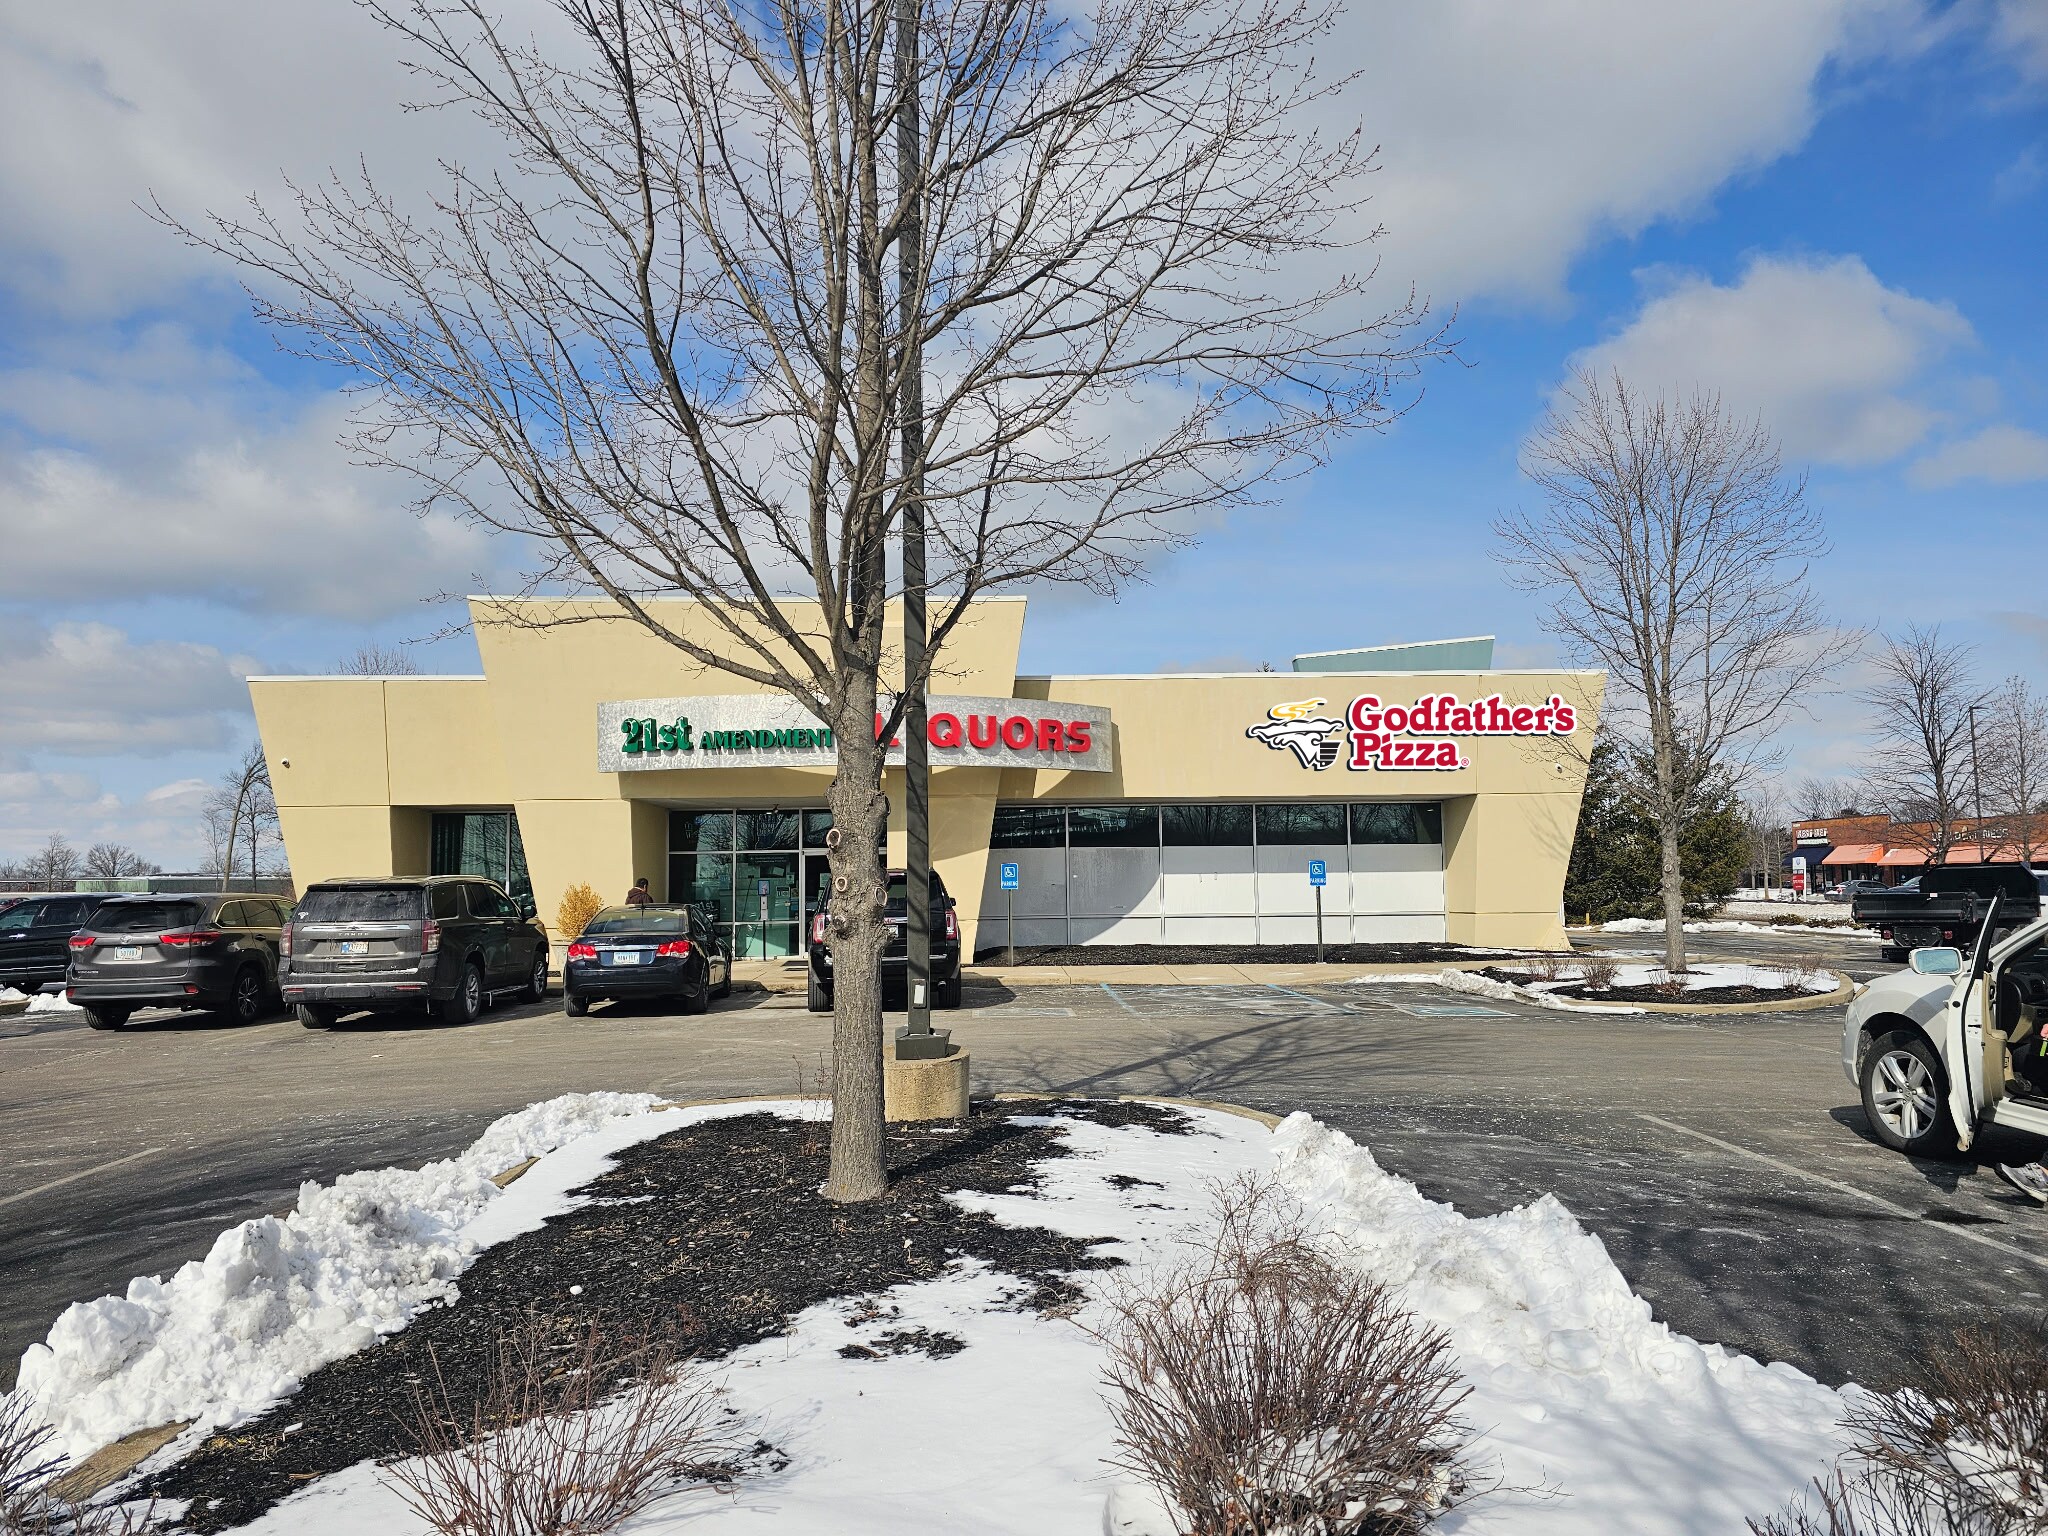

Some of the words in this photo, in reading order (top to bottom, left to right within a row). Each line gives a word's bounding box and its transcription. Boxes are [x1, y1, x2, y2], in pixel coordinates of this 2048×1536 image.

[1351, 696, 1576, 732] Godfather's
[621, 715, 695, 753] 21st
[699, 728, 833, 750] AMENDMENT
[1351, 733, 1460, 767] Pizza
